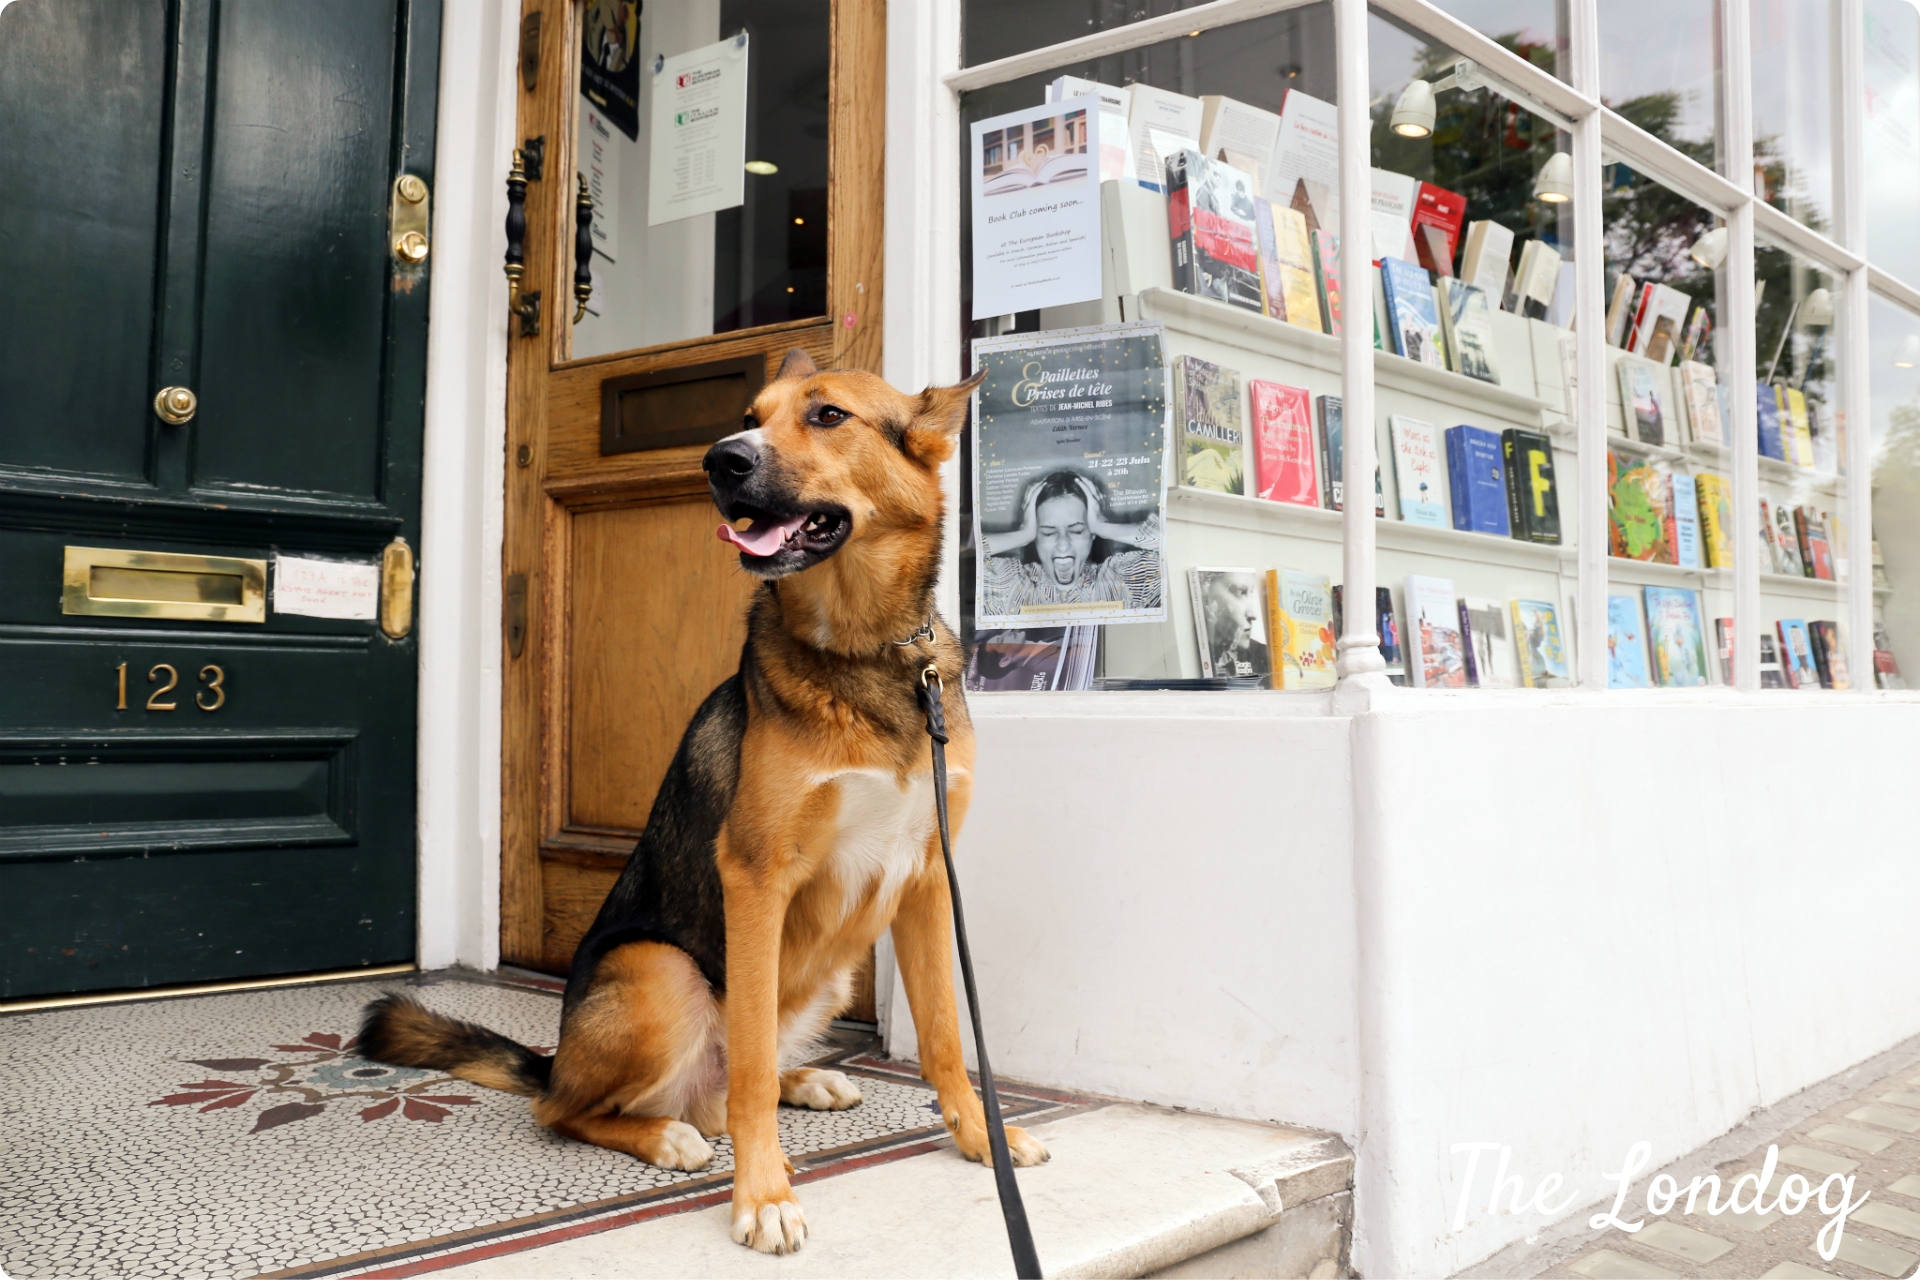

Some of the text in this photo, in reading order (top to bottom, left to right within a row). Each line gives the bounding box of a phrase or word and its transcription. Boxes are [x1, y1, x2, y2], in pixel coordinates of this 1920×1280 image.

[988, 213, 1007, 224] Book
[1009, 208, 1027, 219] Club
[1028, 203, 1058, 216] coming
[1019, 234, 1045, 244] European
[1046, 229, 1071, 239] Bookshop
[1040, 366, 1100, 384] Paillettes
[1026, 382, 1113, 402] Prises de tête
[1030, 398, 1113, 413] TEXTES DE JEAN-MICHEL RIBES
[1030, 417, 1065, 426] ADAPTATION
[1188, 420, 1243, 444] CAMILLERI
[1505, 441, 1513, 459] F
[1088, 455, 1150, 469] 21-22-23 Juin
[1113, 467, 1129, 476] 20h
[1528, 449, 1550, 517] F
[1301, 590, 1323, 606] Olive
[1293, 600, 1322, 616] Groves
[116, 662, 226, 711] 123
